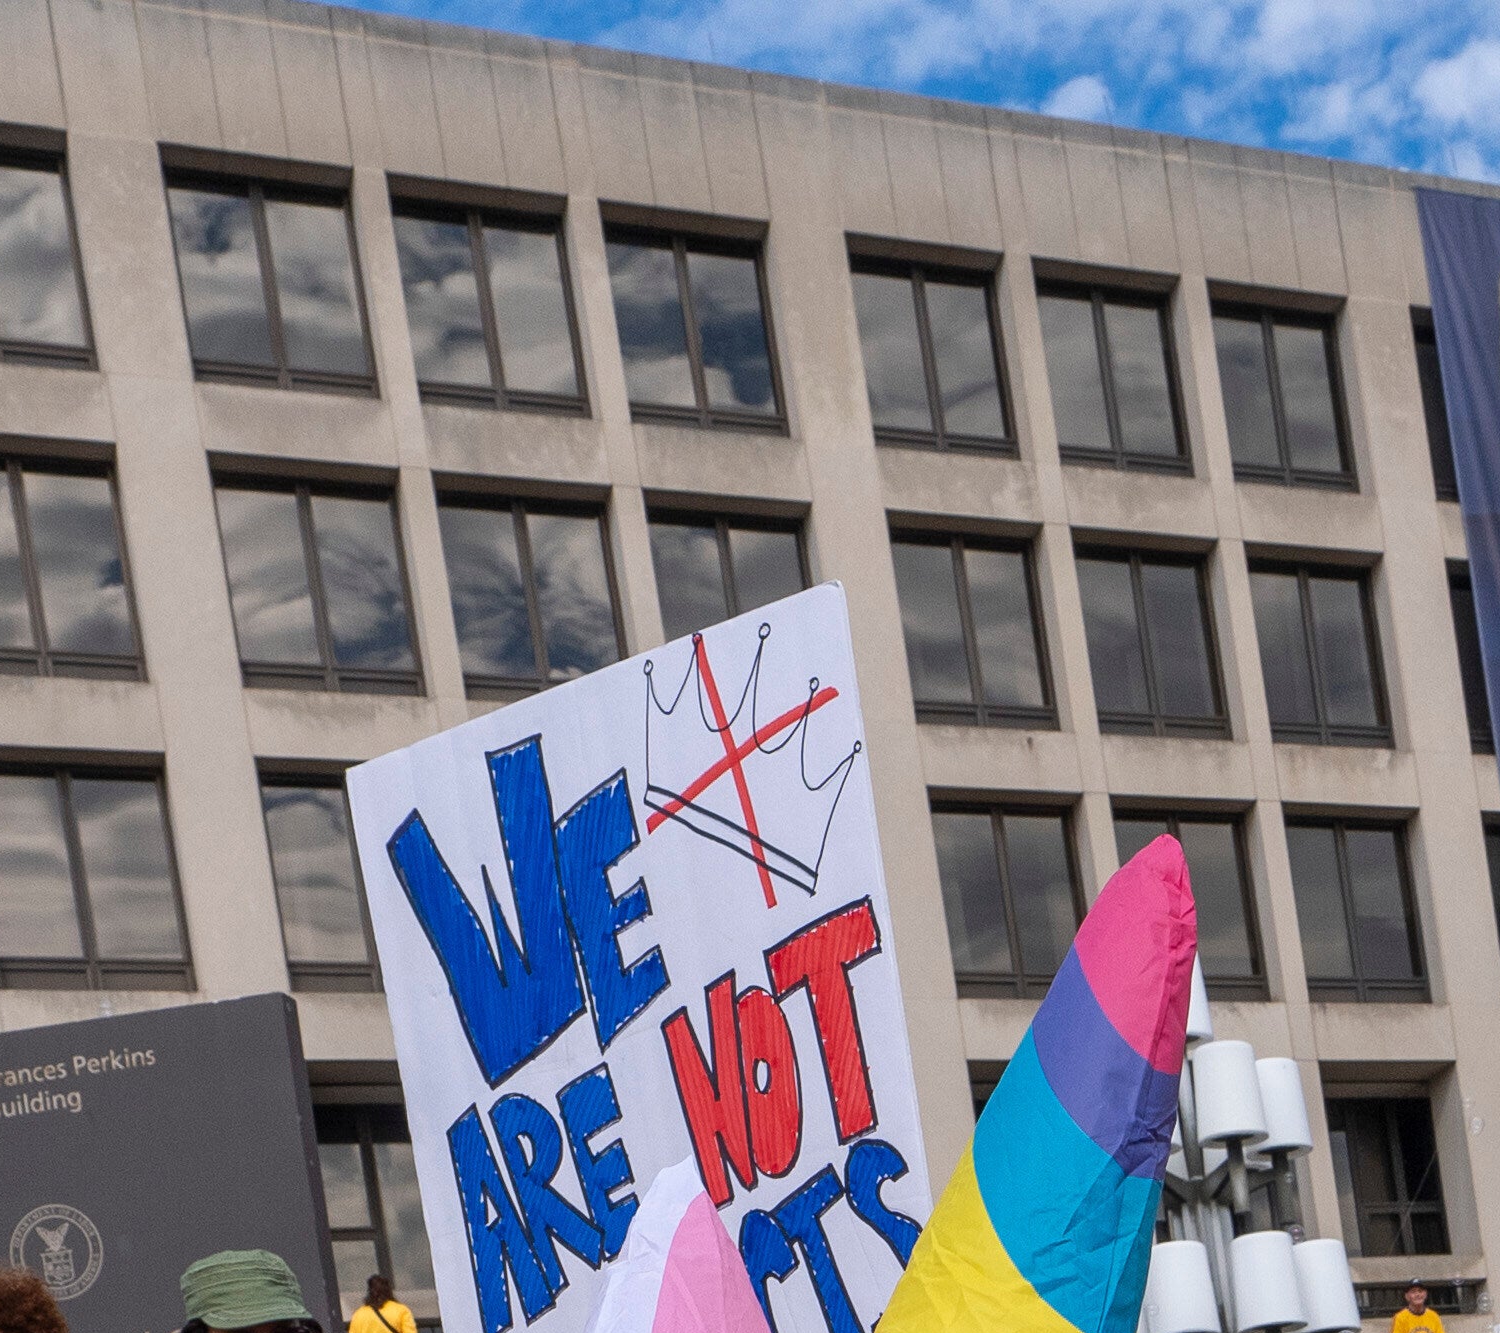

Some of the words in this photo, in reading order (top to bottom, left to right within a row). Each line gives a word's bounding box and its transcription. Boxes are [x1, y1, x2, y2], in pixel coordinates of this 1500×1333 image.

[72, 1048, 156, 1076] Perkins
[387, 733, 670, 1088] WE
[661, 895, 882, 1207] NOT
